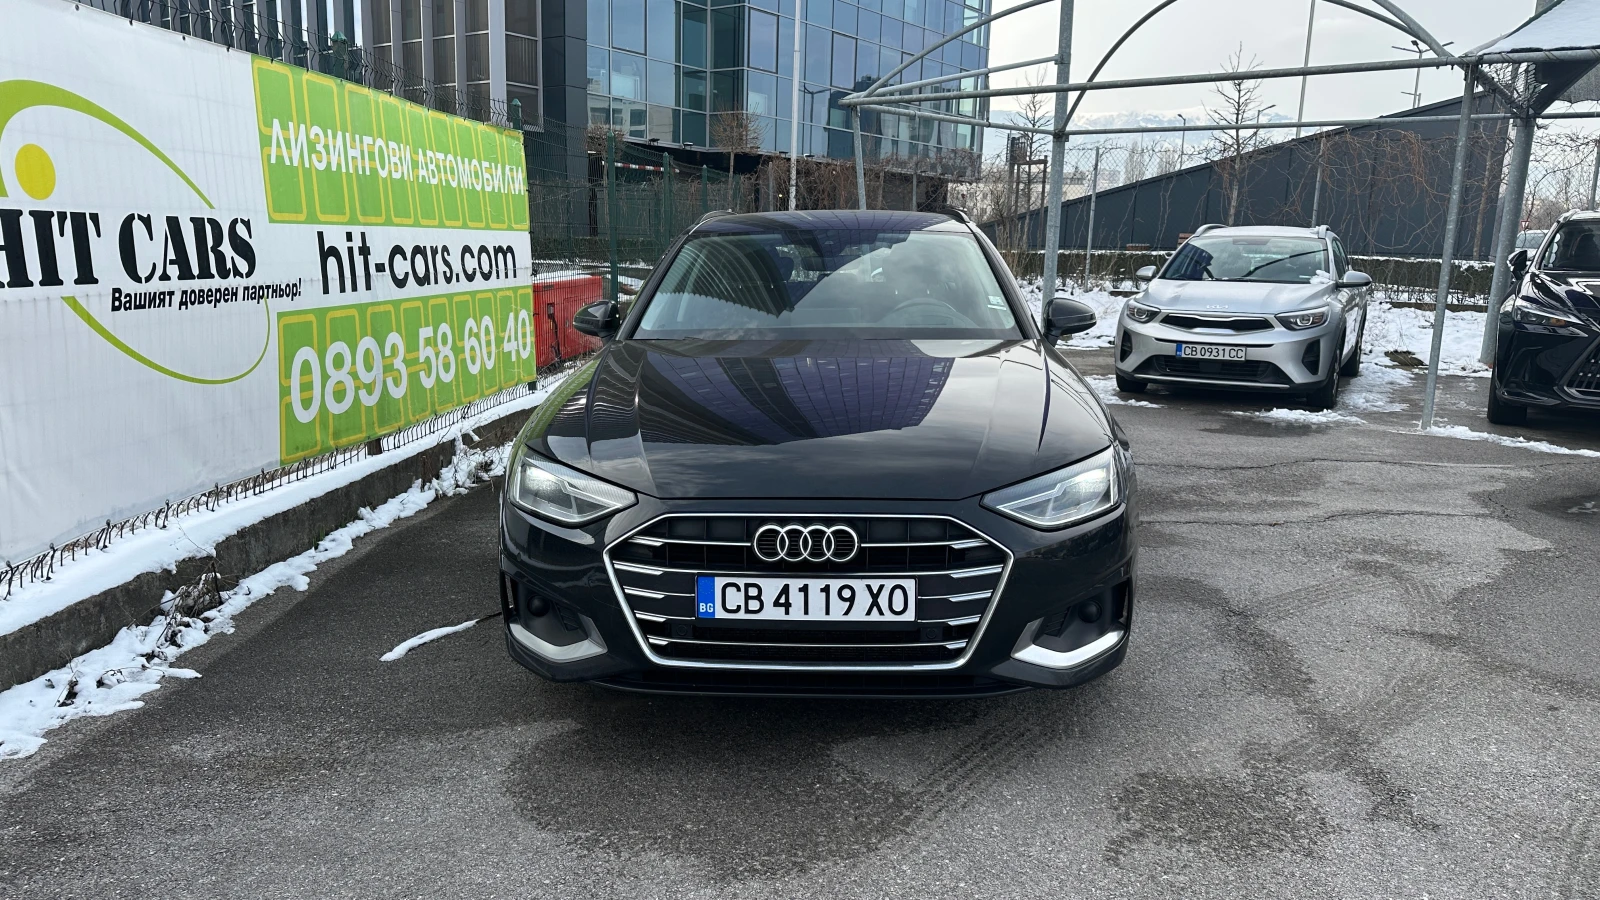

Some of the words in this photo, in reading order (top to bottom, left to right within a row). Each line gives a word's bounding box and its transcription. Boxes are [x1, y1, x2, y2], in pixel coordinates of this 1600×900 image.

[270, 118, 414, 182] ЛИЗИНГОВИ
[418, 147, 524, 195] АВТОМОБИЛИ
[118, 212, 257, 284] CARS
[316, 230, 517, 295] hit-cars.com
[111, 287, 175, 312] Вашият
[178, 284, 238, 311] доверен
[242, 277, 302, 302] партньор!
[290, 331, 408, 424] 0893
[418, 322, 456, 389] 58
[464, 315, 496, 375] 60
[503, 309, 531, 362] 40
[1183, 345, 1198, 357] CB
[1200, 346, 1226, 359] 0931
[1228, 348, 1244, 359] CC
[699, 602, 714, 613] BG
[720, 581, 765, 614] CB
[772, 583, 857, 616] 4119
[865, 583, 909, 616] XO
